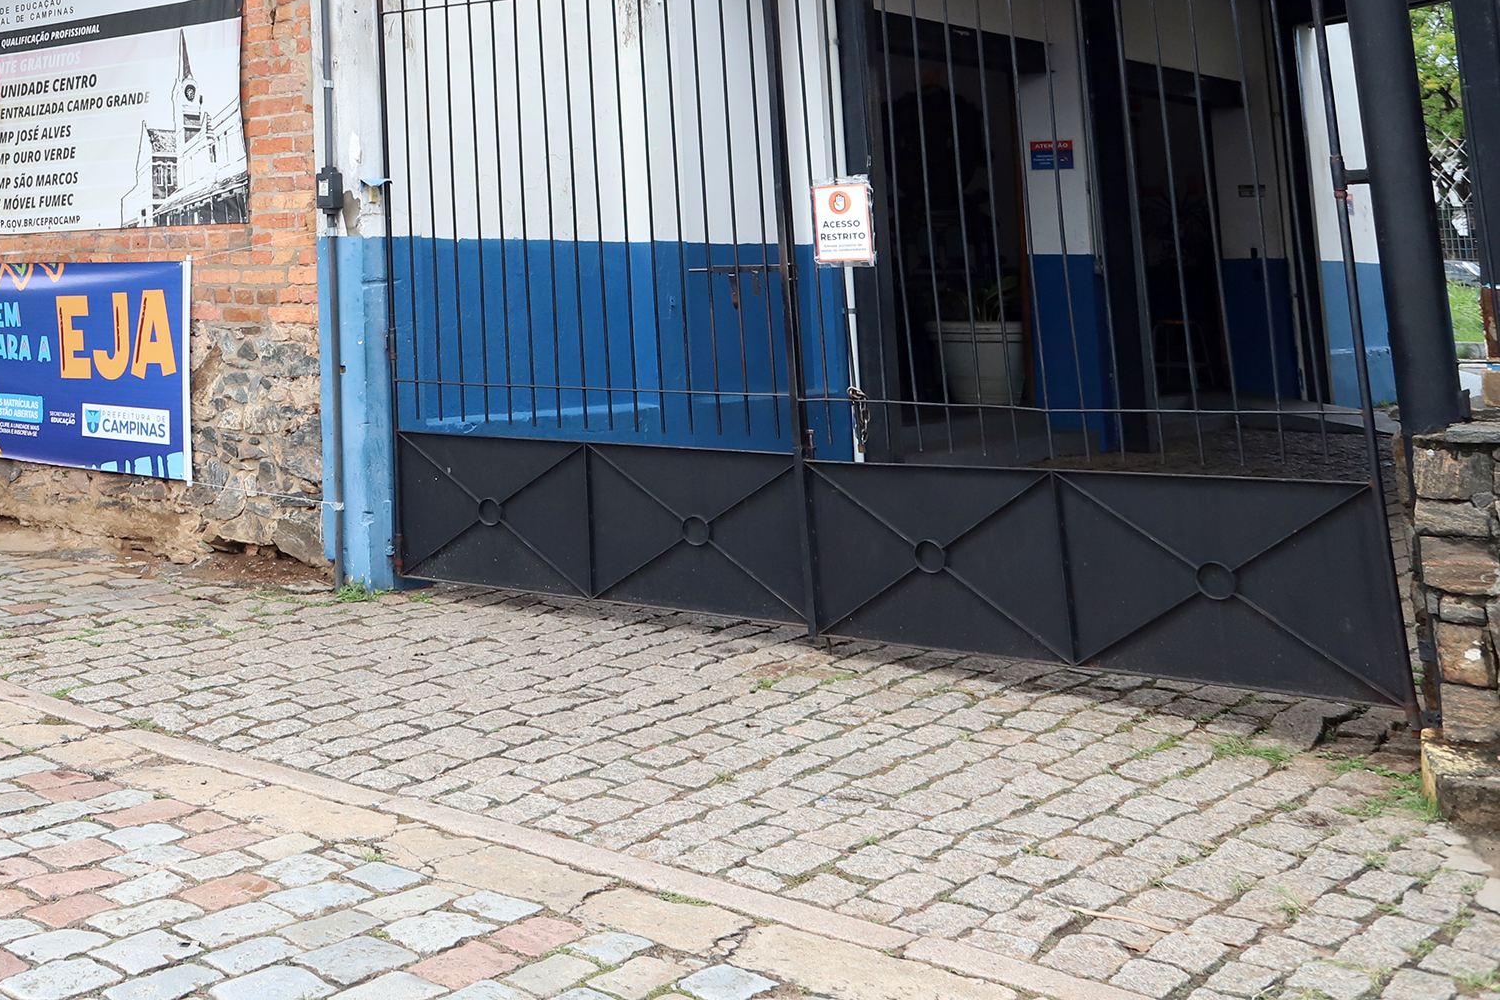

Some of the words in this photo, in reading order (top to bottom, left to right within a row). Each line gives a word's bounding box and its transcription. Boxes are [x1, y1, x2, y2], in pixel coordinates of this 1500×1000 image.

[0, 6, 10, 15] DE
[16, 14, 25, 24] DE
[30, 6, 74, 21] CAMPINAS
[1, 31, 50, 49] QUALIFICAÇÃO
[51, 23, 100, 41] PROFISSIONAL
[20, 51, 81, 73] GRATUITOS
[0, 80, 50, 99] UNIDADE
[52, 73, 97, 93] CENTRO
[66, 96, 103, 113] CAMPO
[106, 91, 149, 108] GRANDE
[15, 125, 39, 146] JOSÉ
[41, 125, 72, 140] ALVES
[13, 150, 41, 164] OURO
[44, 147, 76, 161] VERDE
[13, 173, 34, 189] SÃO
[36, 171, 78, 187] MARCOS
[3, 195, 37, 211] MÓVEL
[39, 194, 74, 208] FUMEC
[823, 220, 860, 228] ACESSO
[820, 232, 866, 241] RESTRITO
[55, 289, 177, 380] EJA
[38, 335, 51, 362] A
[3, 398, 39, 409] MATRÍCULAS
[13, 409, 38, 419] ABERTAS
[49, 410, 70, 418] SECRETARIA
[51, 416, 75, 426] EDUCAÇÃO
[102, 410, 151, 421] PREFEITURA
[156, 415, 166, 423] DE
[102, 418, 166, 438] CAMPINAS
